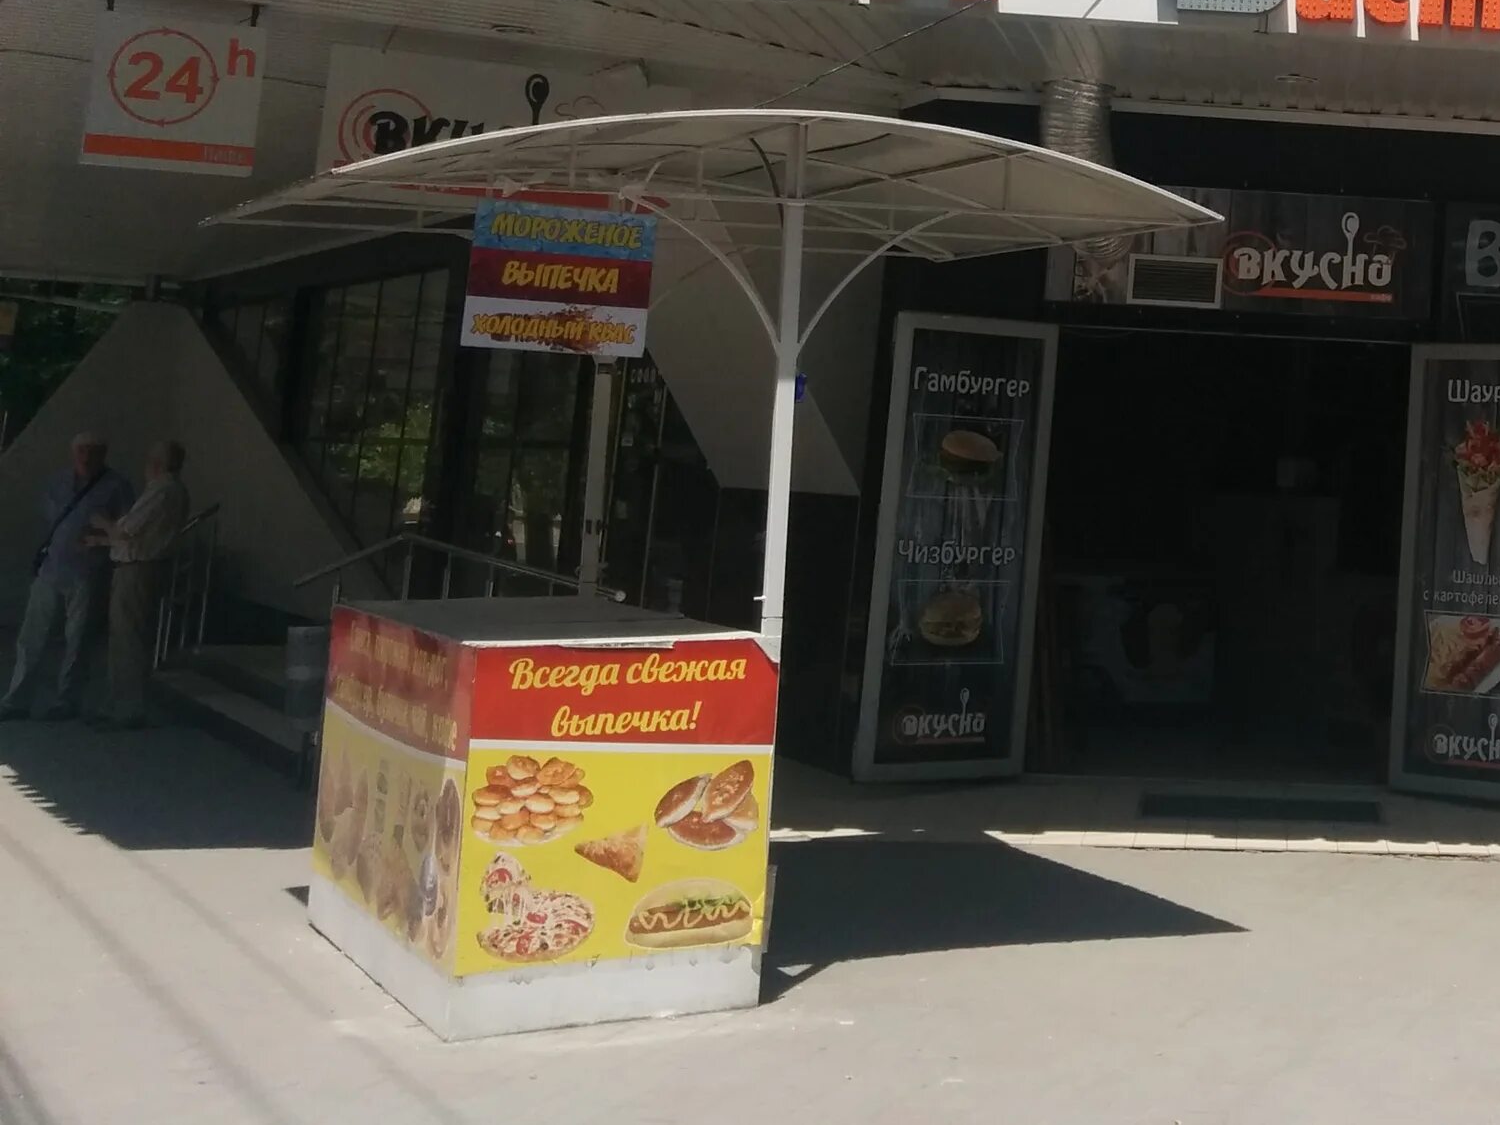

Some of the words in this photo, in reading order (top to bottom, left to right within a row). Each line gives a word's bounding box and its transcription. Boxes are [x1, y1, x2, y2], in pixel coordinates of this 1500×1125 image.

[124, 51, 203, 103] 24
[227, 38, 256, 77] h
[491, 212, 642, 249] МОРОЖЕНОЕ
[502, 261, 619, 293] ВЫПЕЧКА
[471, 313, 586, 341] ХОЛОДНЫЙ
[589, 321, 637, 344] КВАС
[914, 367, 1030, 398] Гамбургер
[897, 539, 1017, 567] Чизбургер
[508, 657, 621, 696] Всегда
[626, 653, 747, 684] свежая
[551, 701, 702, 738] выпечка!
